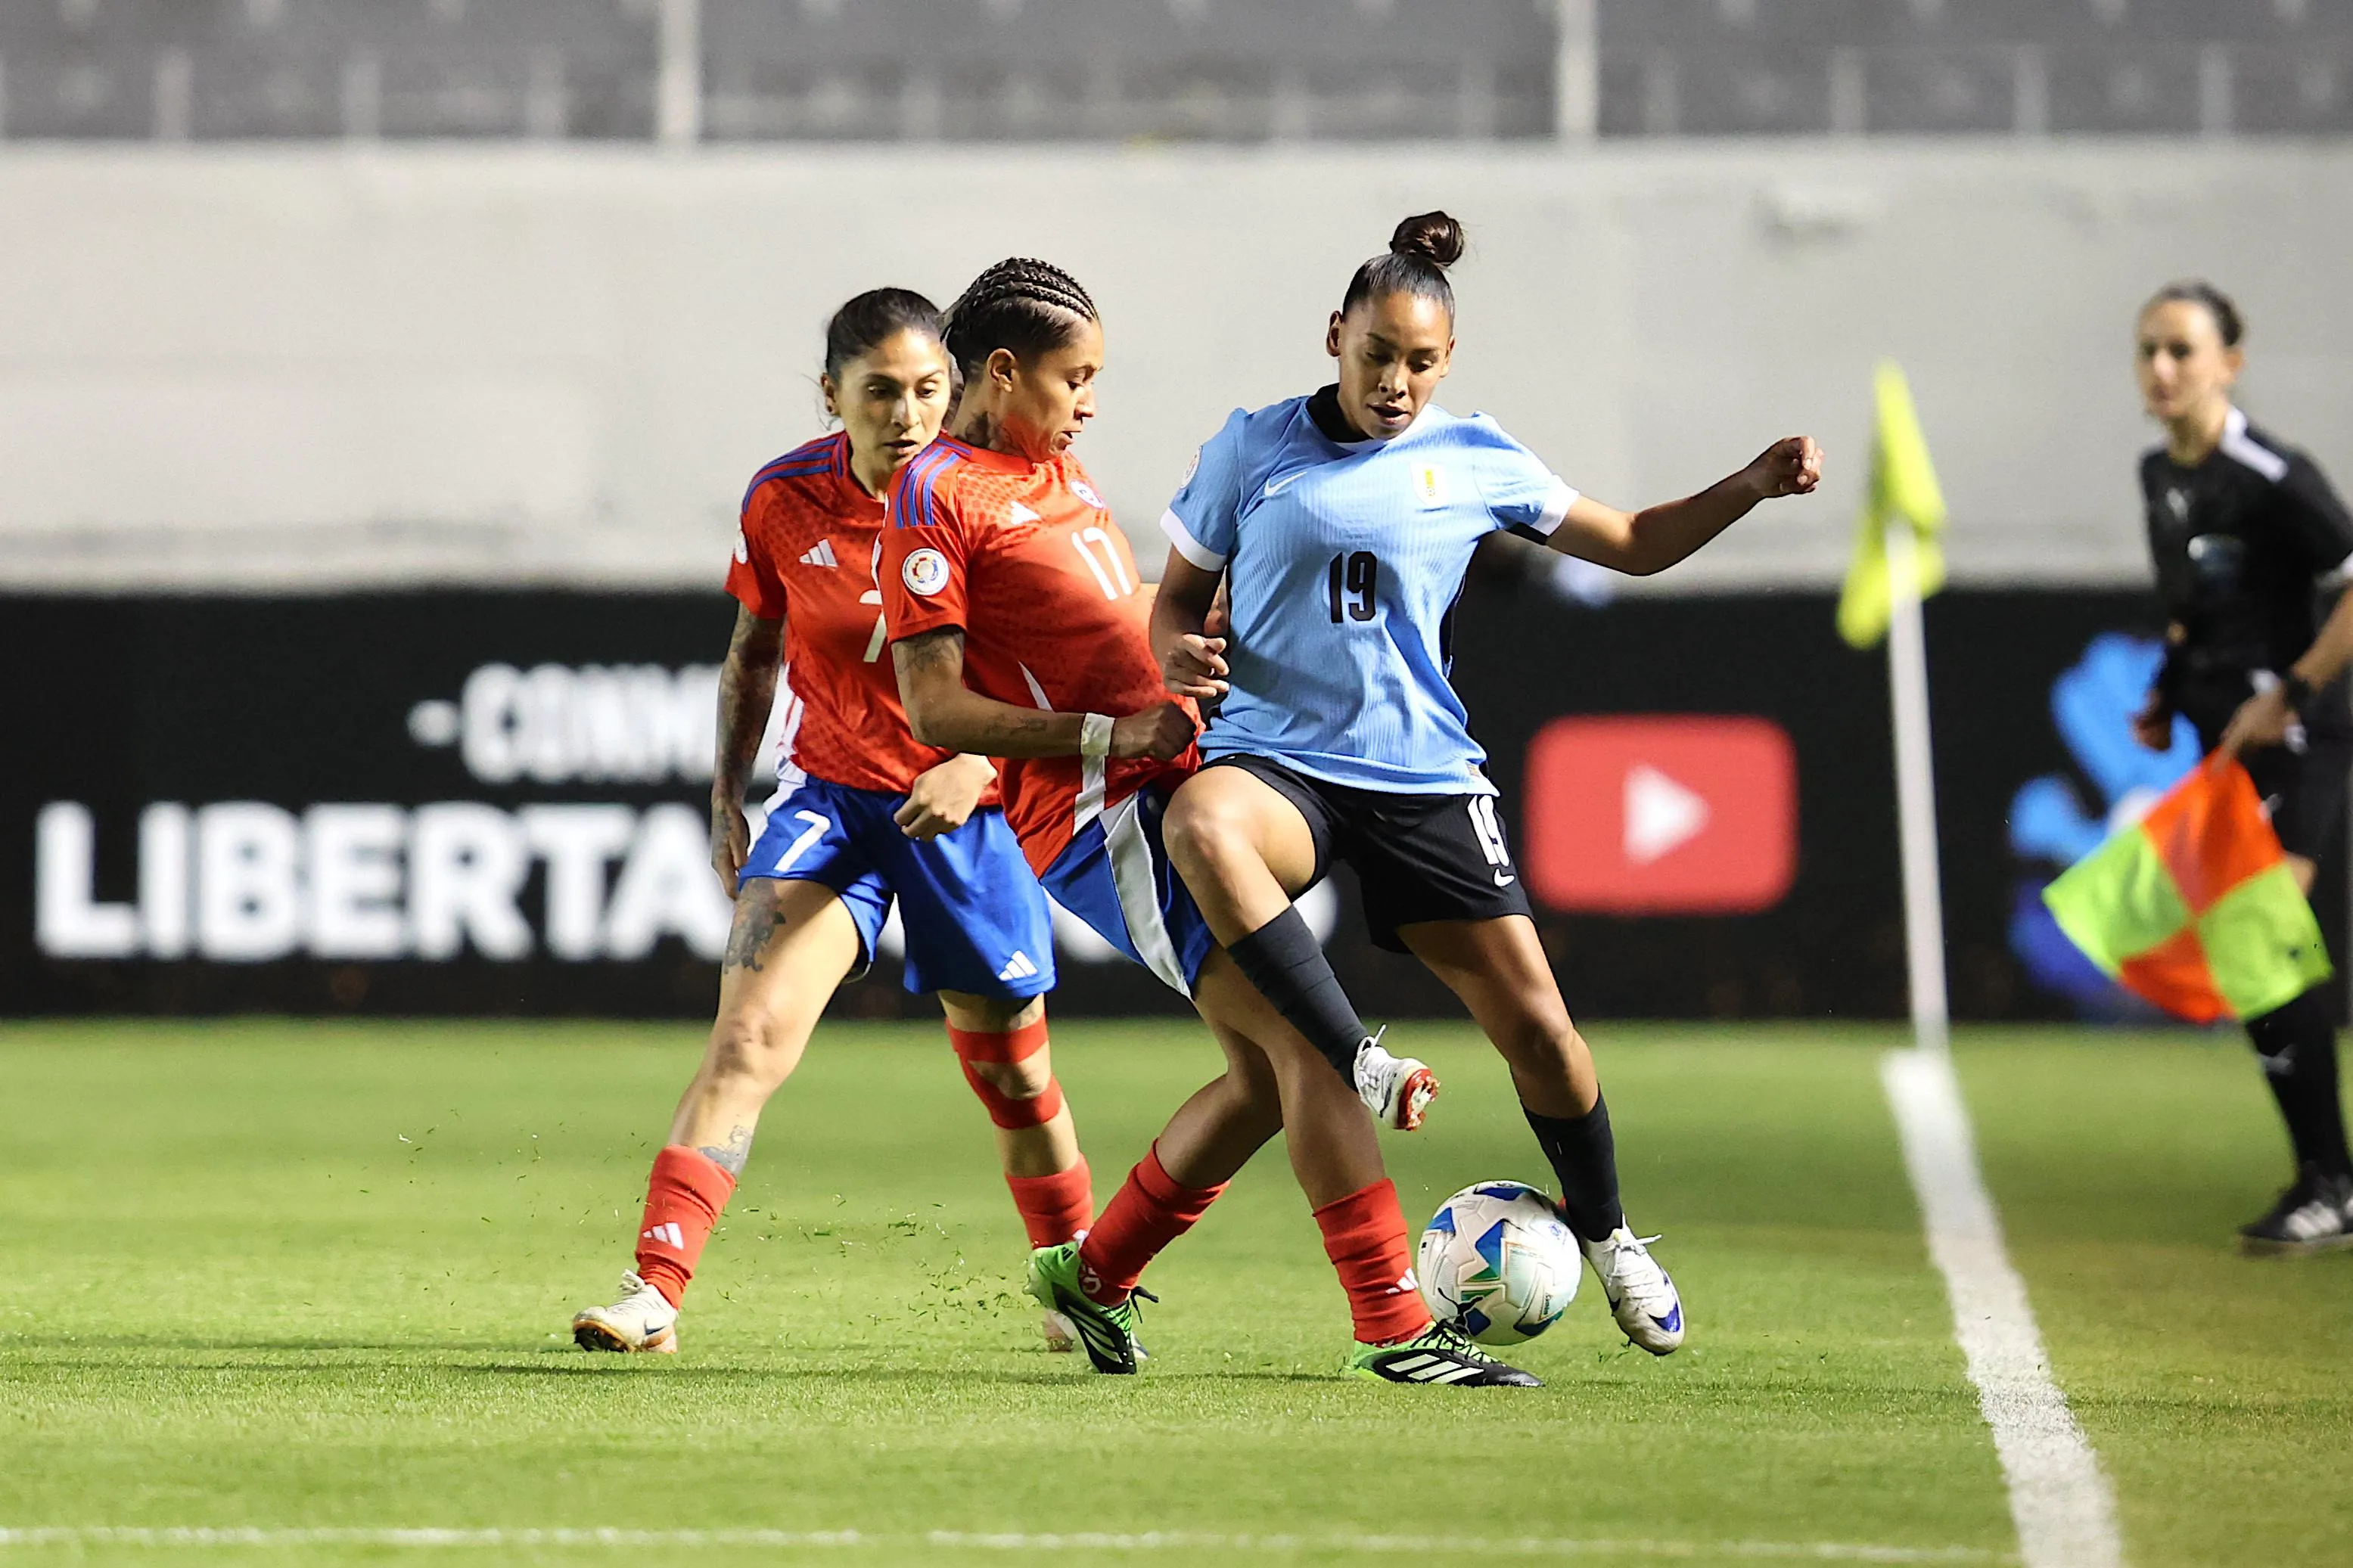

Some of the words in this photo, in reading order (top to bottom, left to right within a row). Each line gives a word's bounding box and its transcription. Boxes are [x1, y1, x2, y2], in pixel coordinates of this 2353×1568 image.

[1071, 526, 1133, 601] 17
[1329, 551, 1378, 623] 19
[859, 589, 887, 663] 7
[773, 809, 831, 872] 7
[1467, 795, 1510, 867] 19
